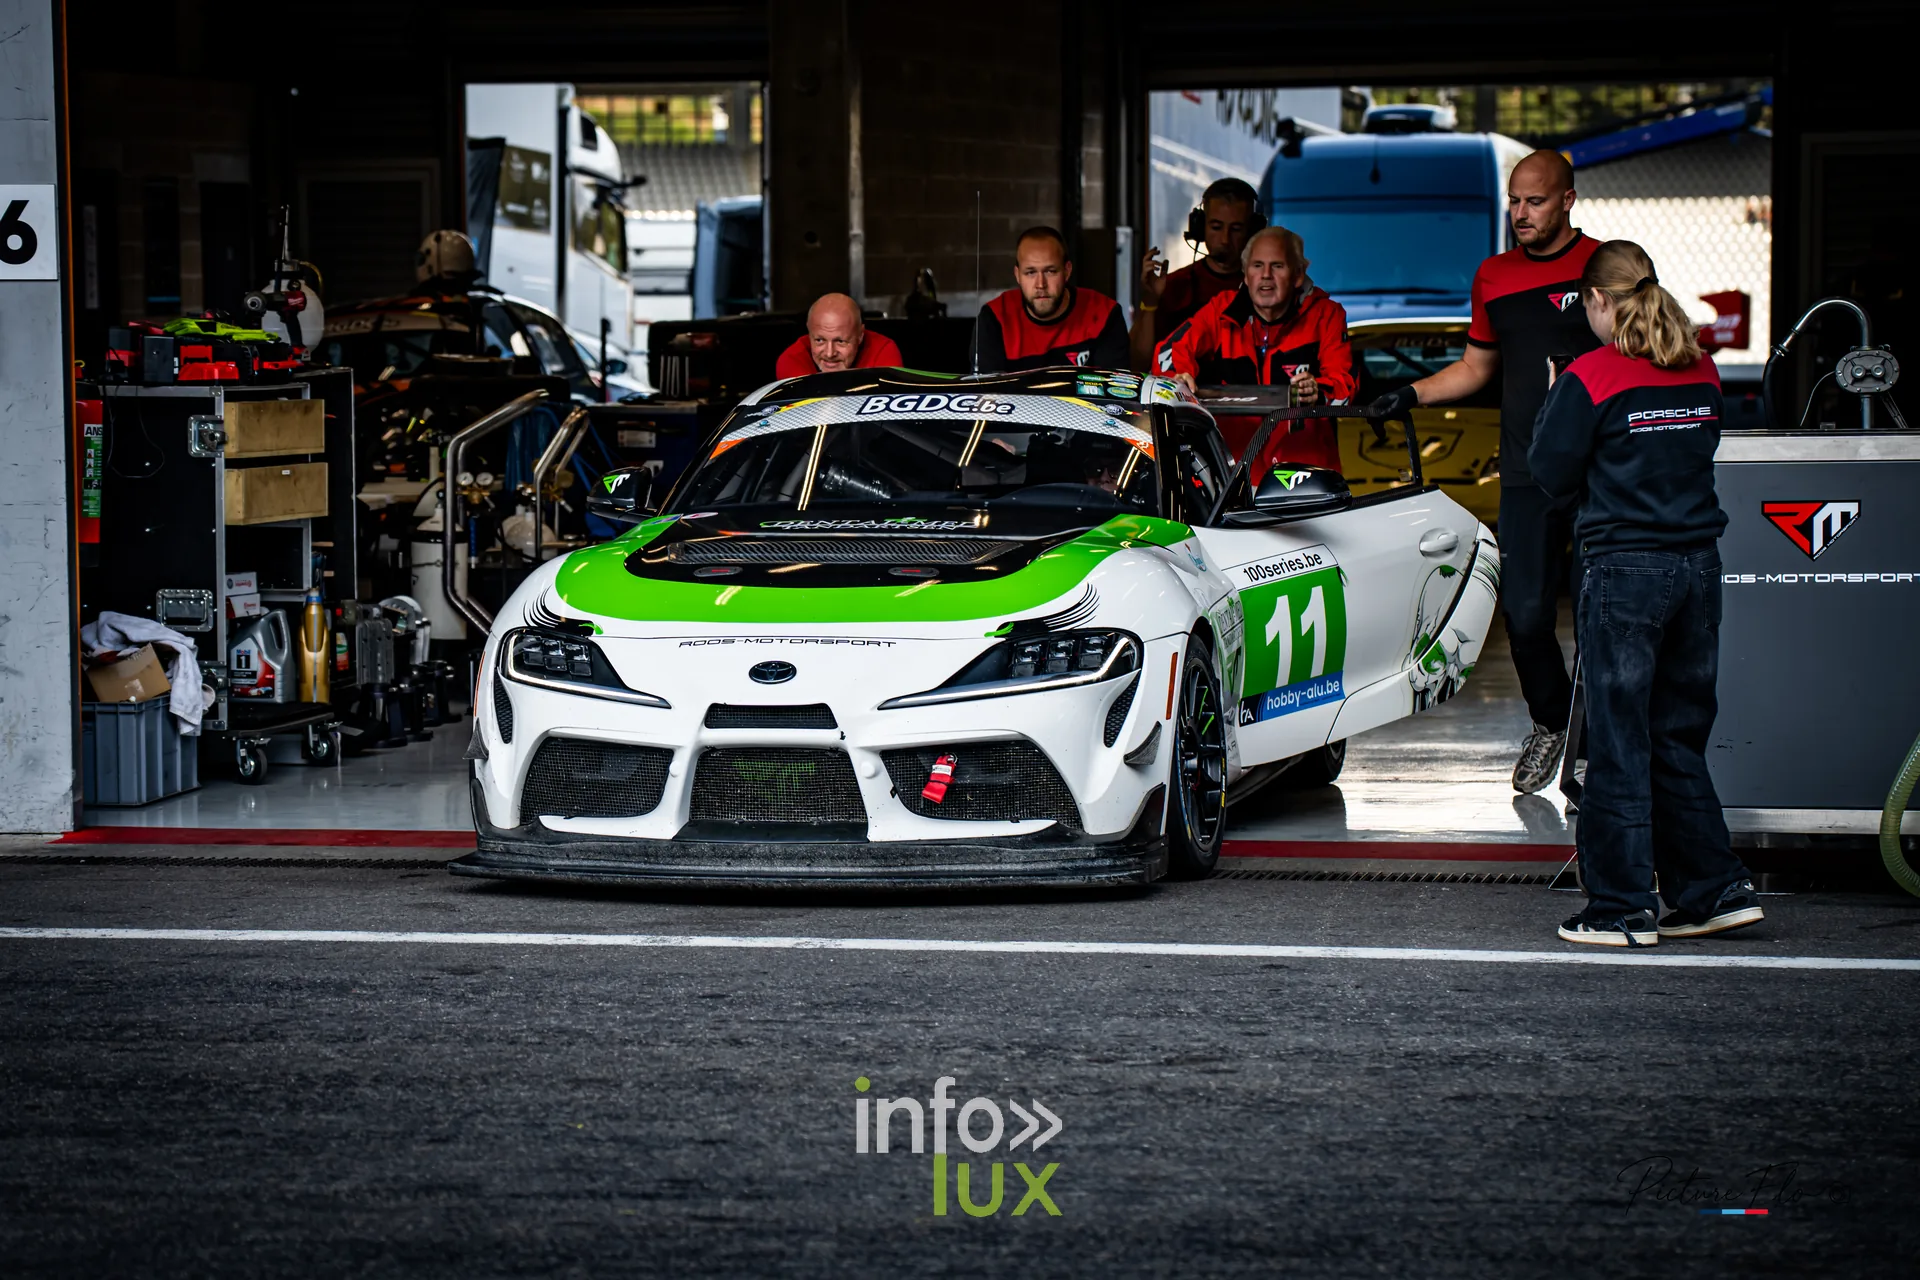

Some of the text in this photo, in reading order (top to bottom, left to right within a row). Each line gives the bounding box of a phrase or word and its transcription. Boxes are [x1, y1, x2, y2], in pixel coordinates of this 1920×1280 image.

[0, 199, 38, 265] 6
[857, 393, 1016, 415] BGDC.be
[1627, 406, 1712, 423] PORSCHE
[1243, 552, 1323, 582] 100series.be
[1721, 573, 1920, 584] OS-MOTORSPOR
[679, 638, 897, 648] ROOS-MOTORSPORT
[1264, 584, 1327, 689] 11
[1266, 679, 1340, 711] hobby-alu.be
